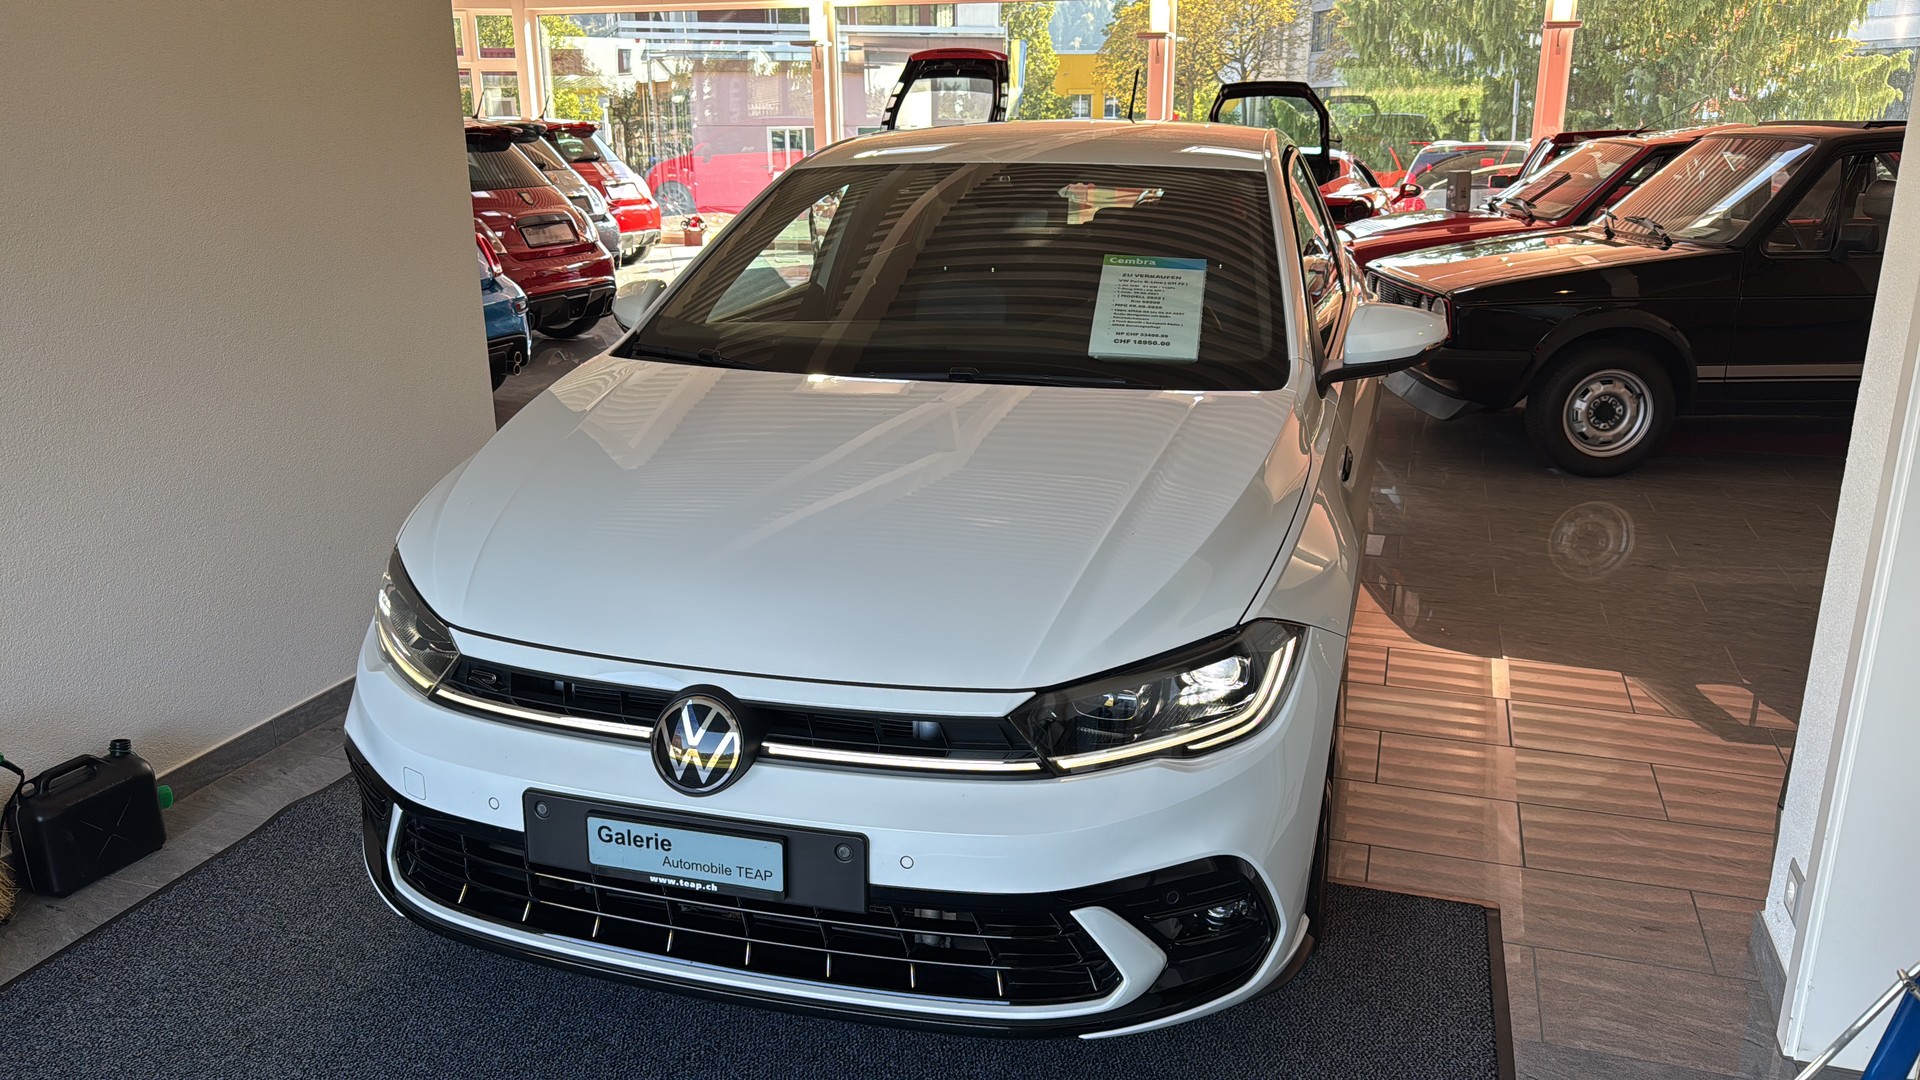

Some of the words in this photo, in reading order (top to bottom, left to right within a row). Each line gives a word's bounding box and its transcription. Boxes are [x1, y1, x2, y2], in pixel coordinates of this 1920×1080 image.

[1109, 256, 1157, 266] Cembra
[1133, 339, 1171, 347] 18950.00
[655, 696, 740, 787] VW
[597, 825, 673, 852] Galerie
[662, 855, 733, 877] Automobile
[735, 865, 773, 882] TEAP
[649, 874, 718, 893] www.teap.ch
